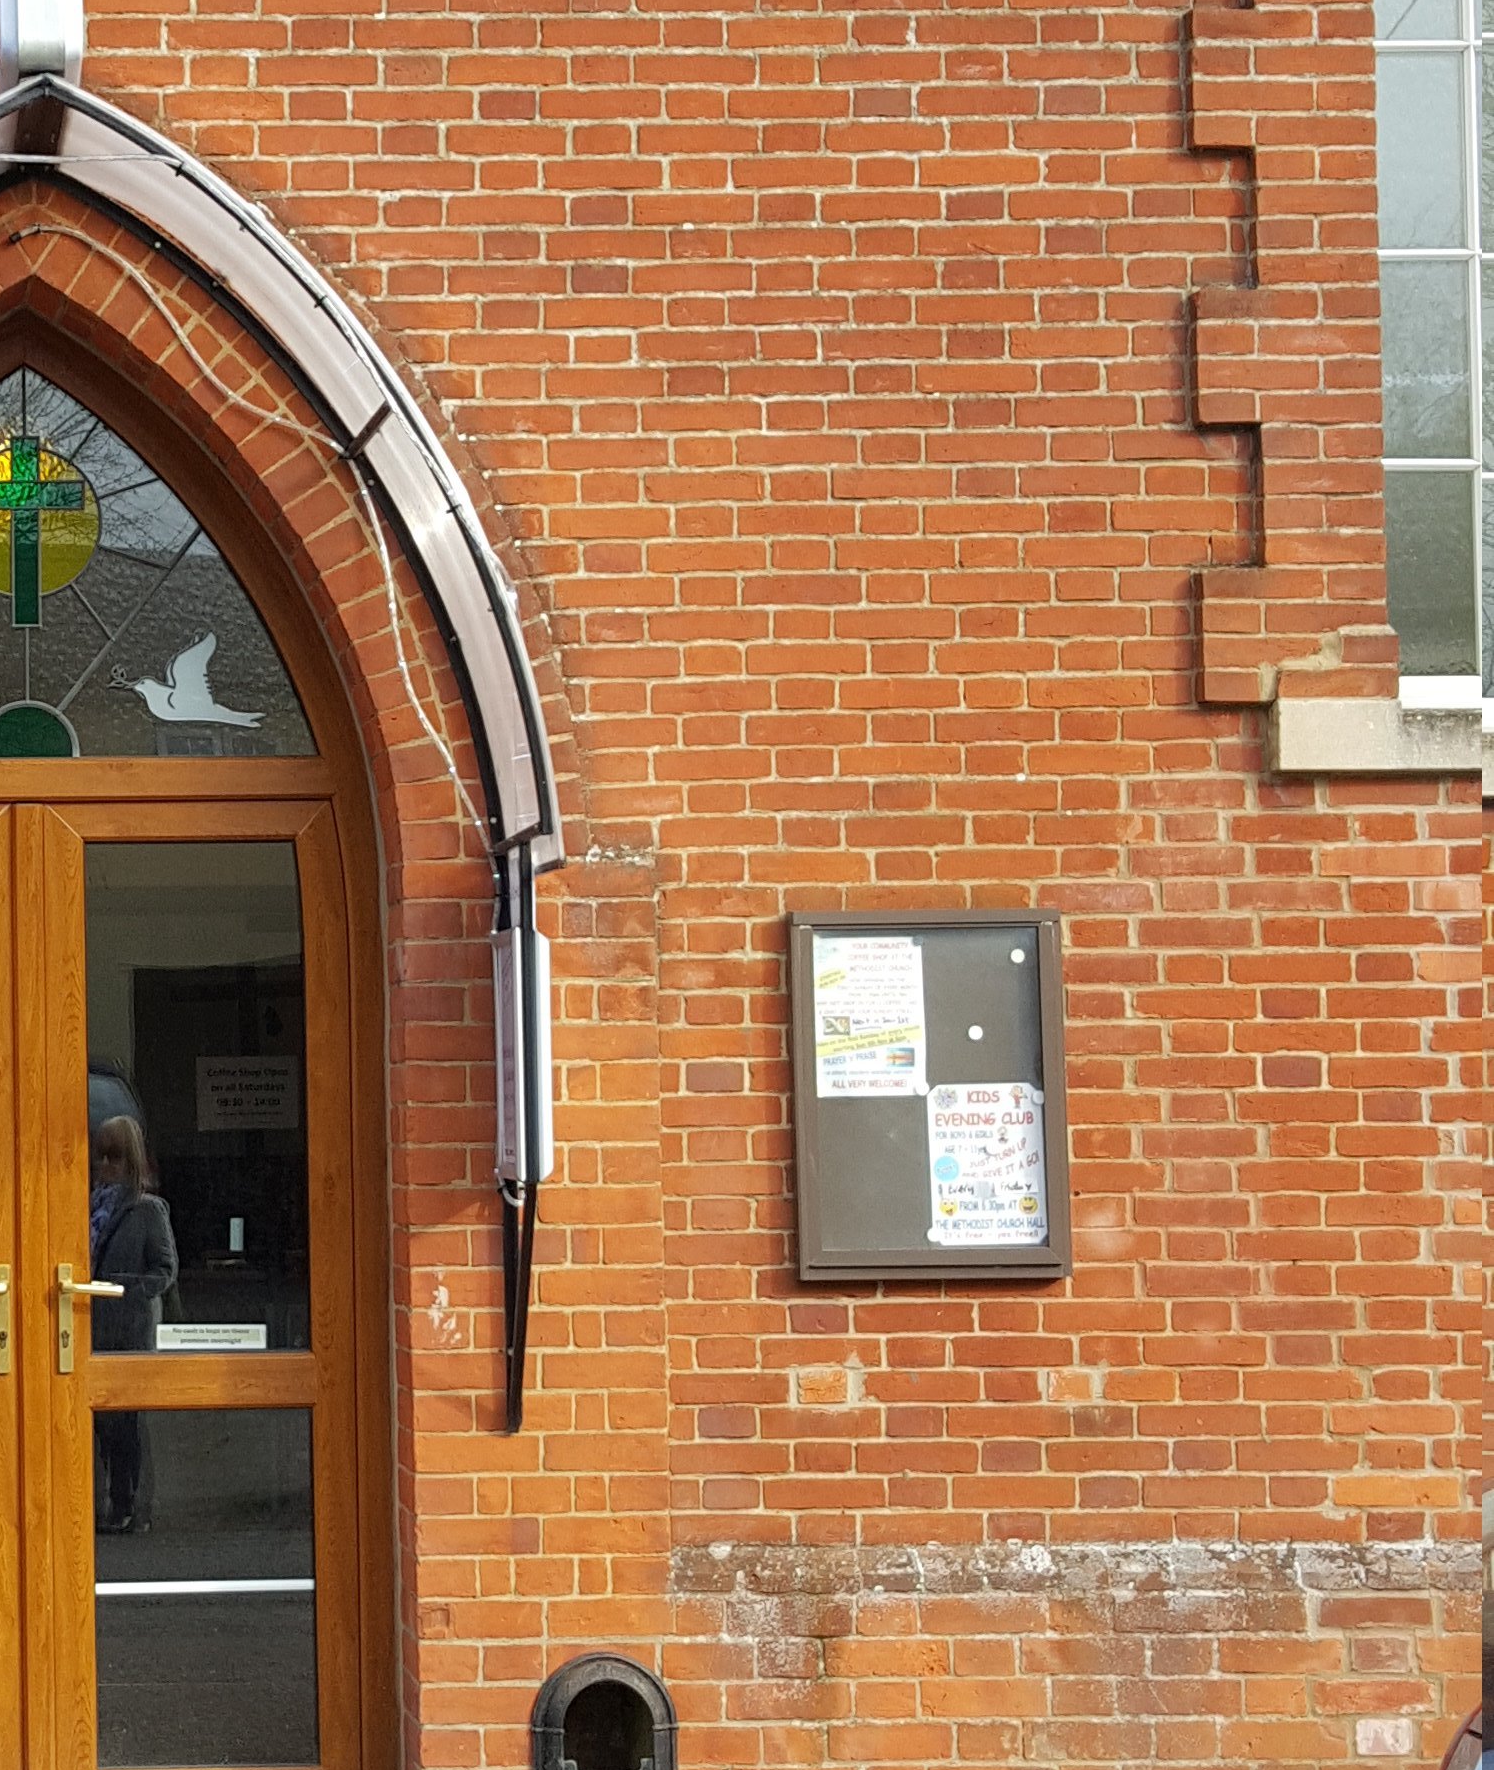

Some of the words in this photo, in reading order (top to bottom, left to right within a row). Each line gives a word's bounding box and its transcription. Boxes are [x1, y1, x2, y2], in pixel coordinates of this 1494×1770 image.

[967, 1090, 1000, 1104] KIDS
[935, 1113, 996, 1127] EVENING
[1001, 1111, 1034, 1125] CLUB
[935, 1220, 949, 1229] THE
[952, 1219, 994, 1229] METHODIST
[997, 1218, 1025, 1228] CHURCH
[1026, 1217, 1045, 1228] HALL
